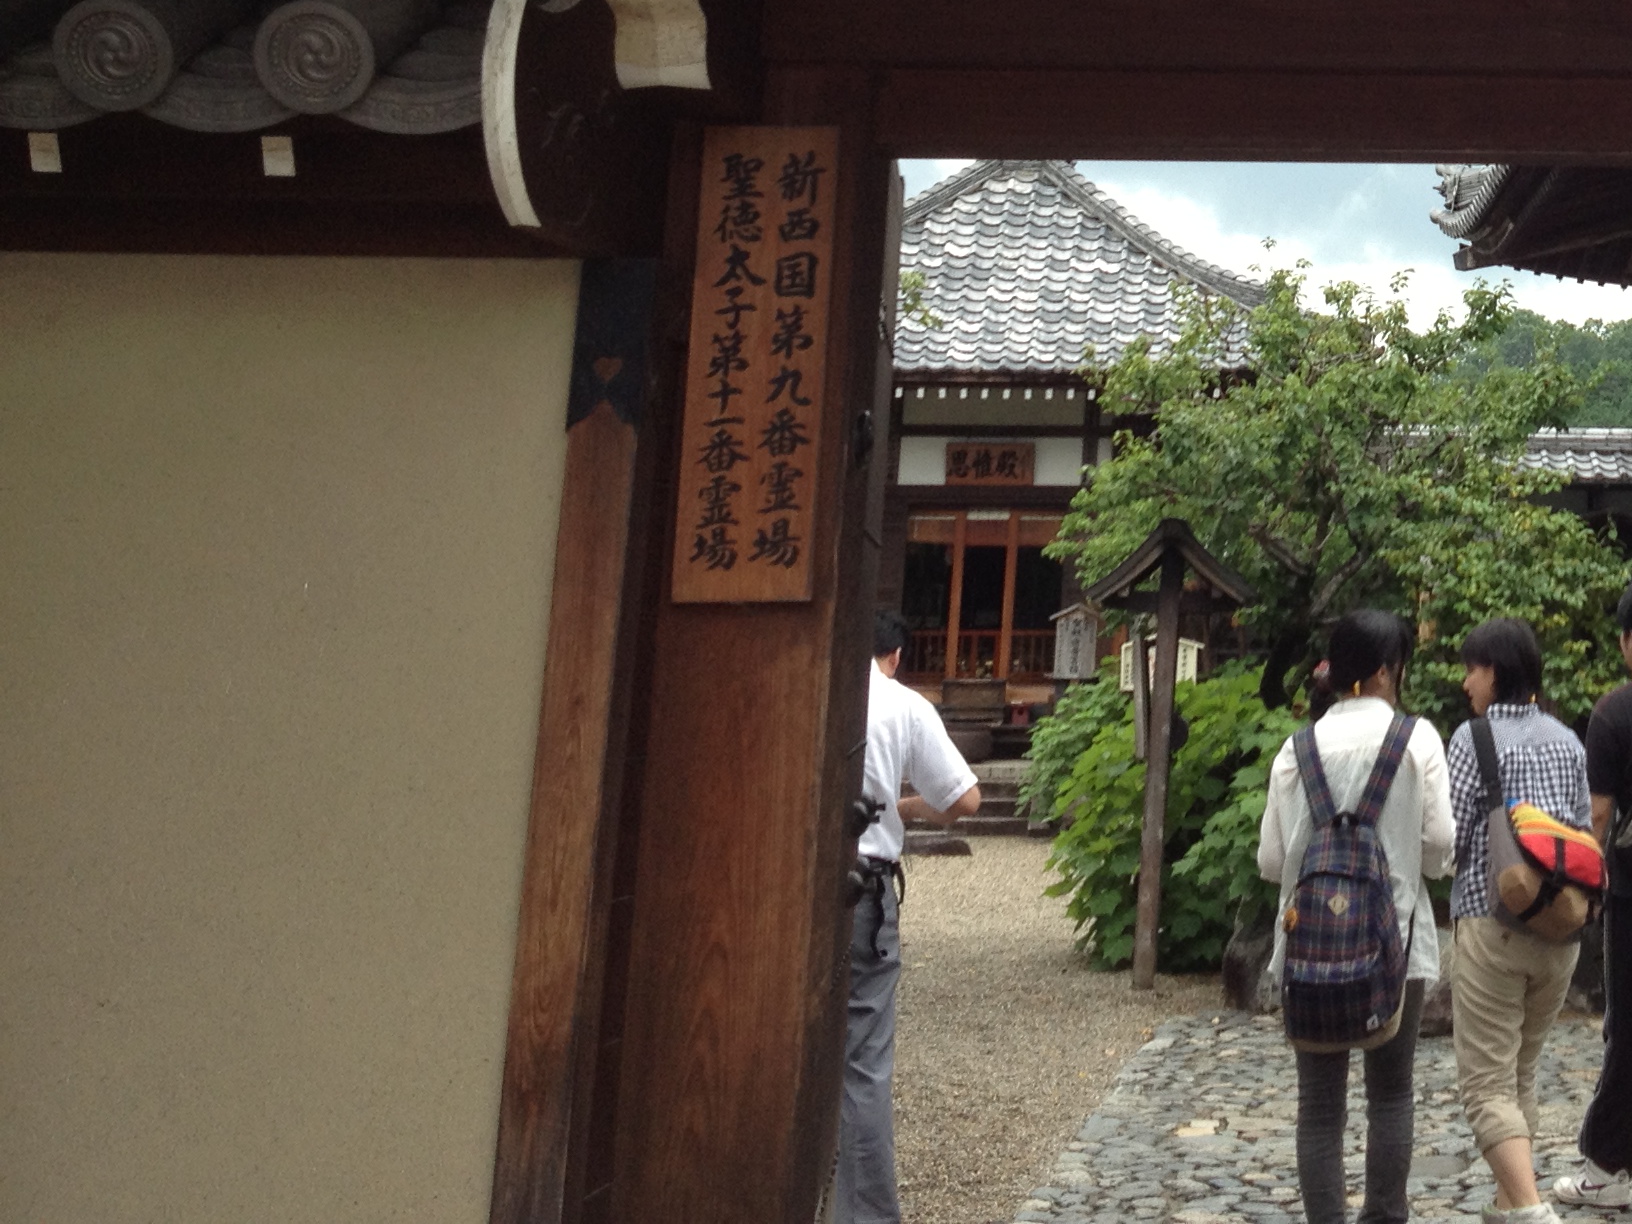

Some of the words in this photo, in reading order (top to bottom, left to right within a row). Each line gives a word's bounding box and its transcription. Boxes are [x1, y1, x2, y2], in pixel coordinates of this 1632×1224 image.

[747, 150, 826, 570] 新西国第九番霊場
